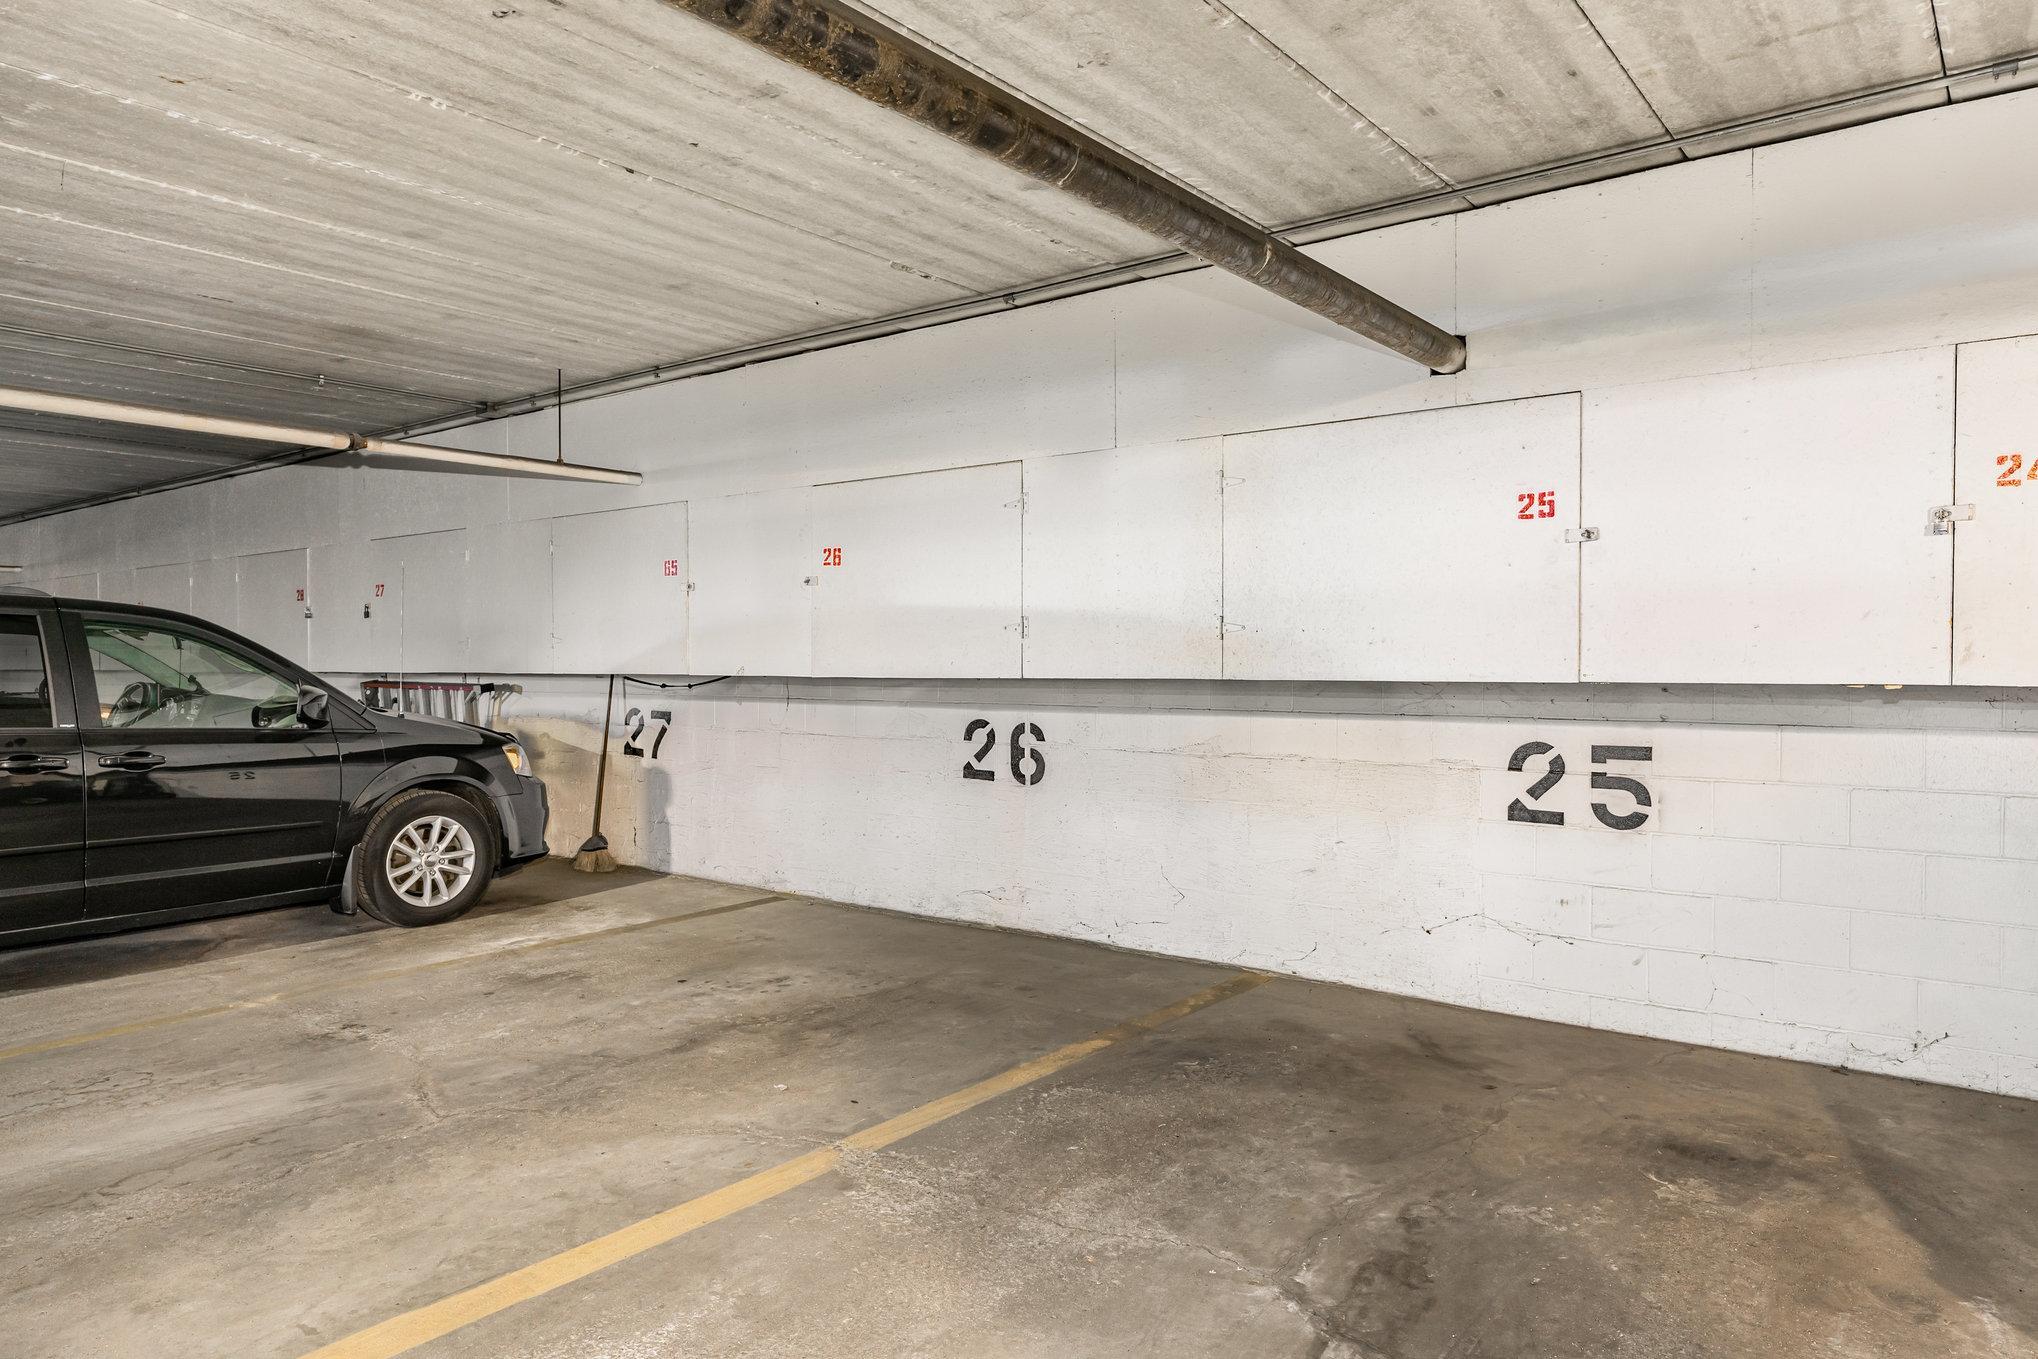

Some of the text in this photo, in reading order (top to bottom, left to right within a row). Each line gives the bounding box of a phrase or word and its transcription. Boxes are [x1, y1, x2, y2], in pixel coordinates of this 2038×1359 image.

[1517, 491, 1555, 520] 25
[823, 547, 842, 566] 26
[375, 584, 385, 597] 27
[624, 707, 672, 760] 27
[963, 718, 1046, 786] 26
[1507, 741, 1653, 831] 25
